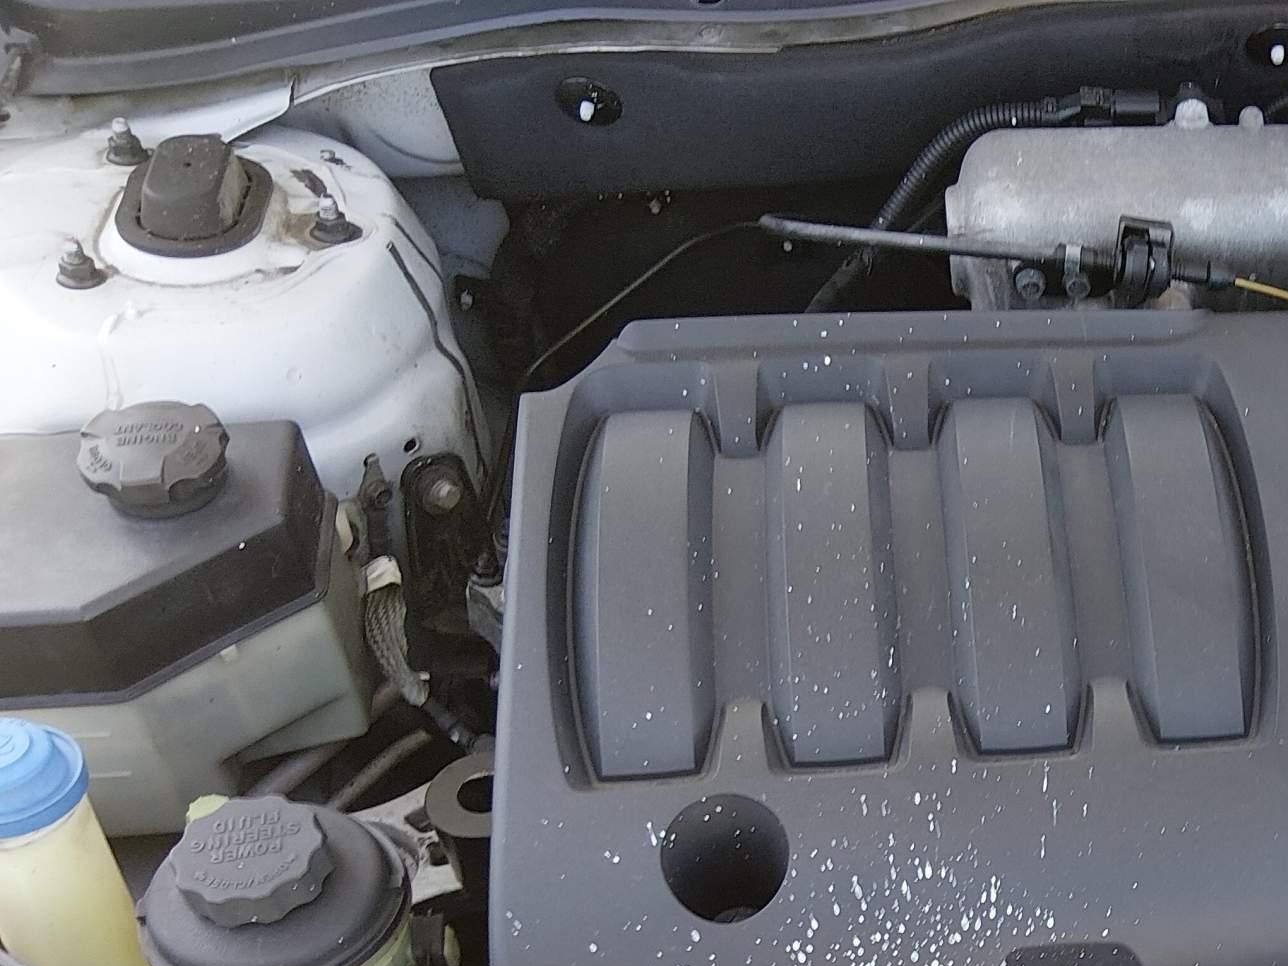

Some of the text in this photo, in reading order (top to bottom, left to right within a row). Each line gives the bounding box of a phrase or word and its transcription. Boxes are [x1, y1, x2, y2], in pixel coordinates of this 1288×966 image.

[113, 421, 184, 436] COOLANT
[116, 434, 178, 447] ENGINE
[212, 809, 281, 834] FLUID
[190, 823, 301, 854] STEERING
[210, 838, 283, 864] POWER
